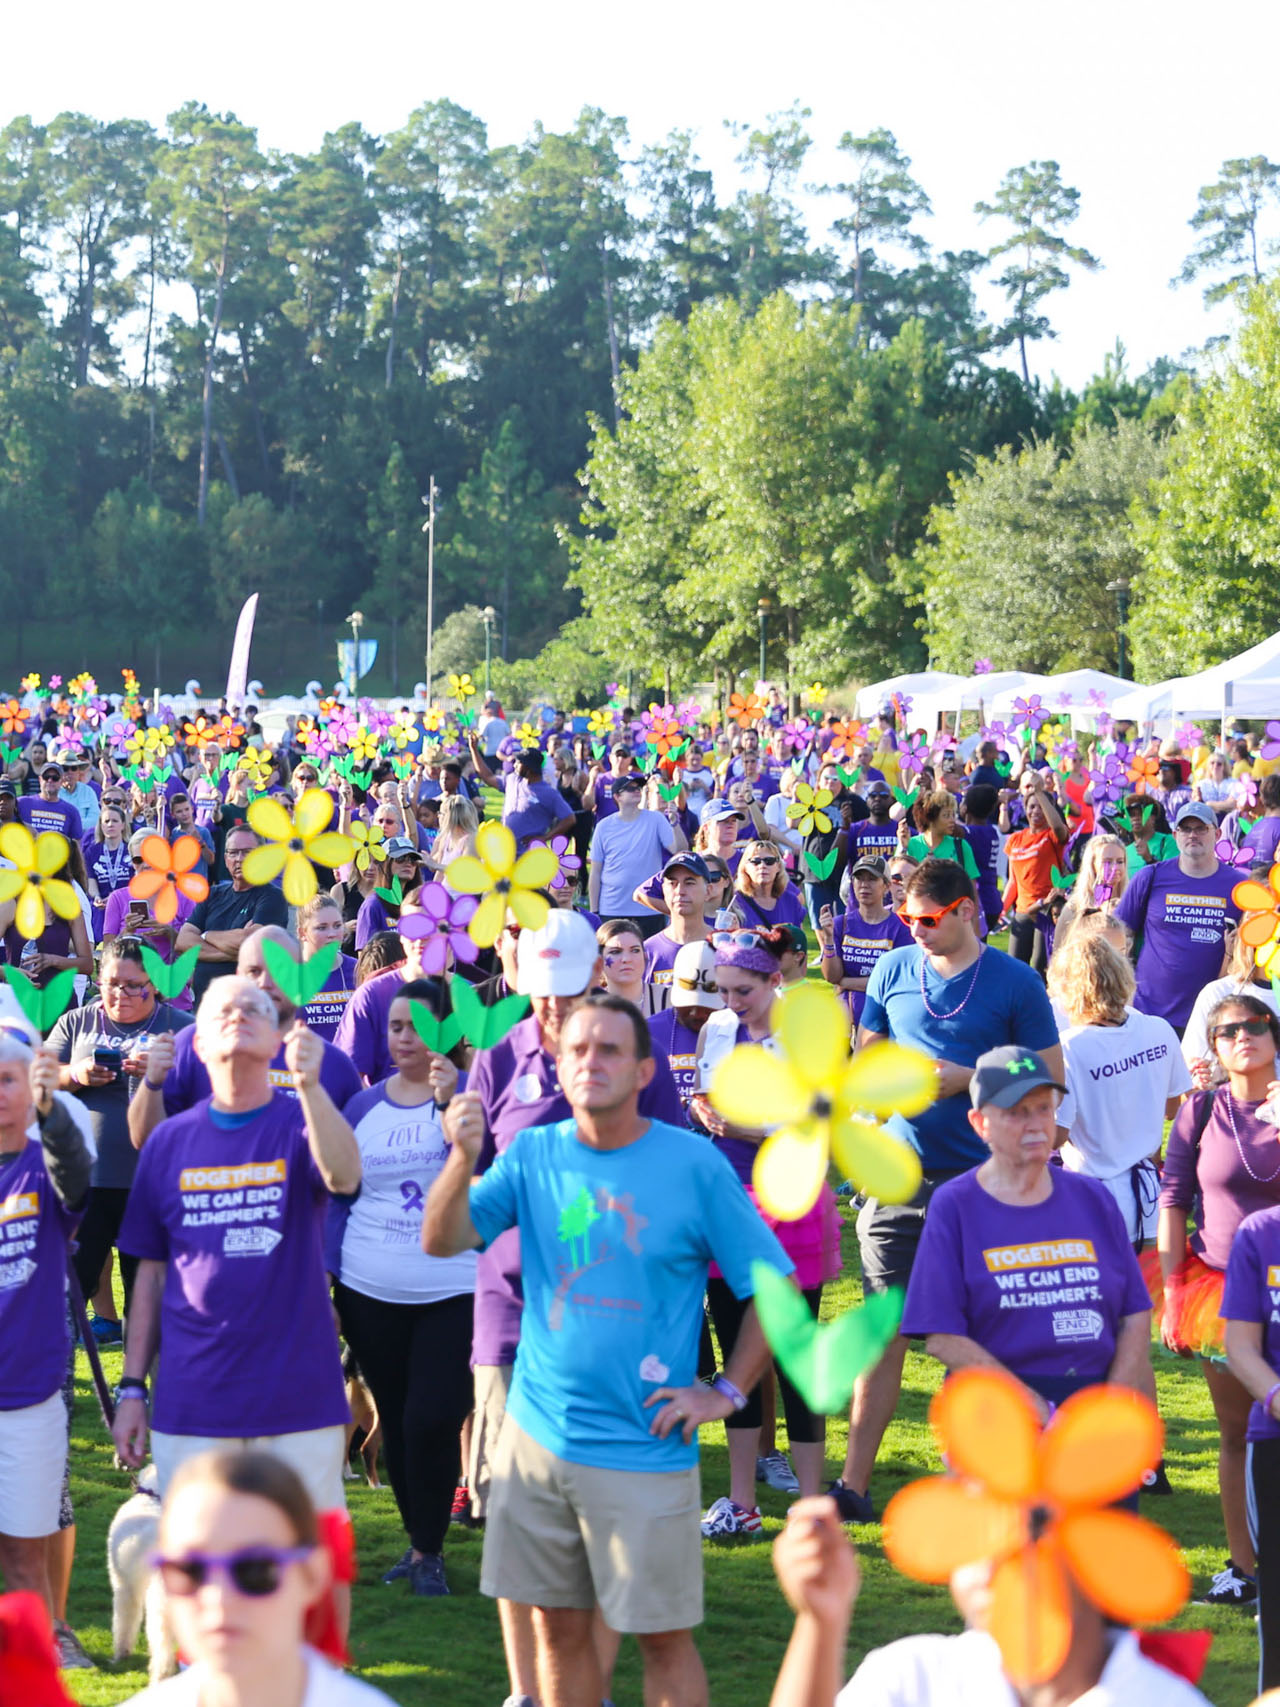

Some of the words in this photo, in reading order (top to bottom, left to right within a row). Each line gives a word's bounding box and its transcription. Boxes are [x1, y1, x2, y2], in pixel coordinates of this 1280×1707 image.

[1166, 906, 1182, 914] WE
[1183, 907, 1203, 915] CAN
[1205, 908, 1225, 917] END
[305, 1005, 323, 1014] WE
[324, 1004, 344, 1013] CAN
[1089, 1044, 1168, 1081] VOLUNTEER
[182, 1193, 210, 1209] WE
[212, 1190, 244, 1208] CAN
[247, 1186, 282, 1204] END
[994, 1273, 1027, 1289] WE
[1028, 1270, 1062, 1287] CAN
[1062, 1266, 1100, 1283] END
[999, 1286, 1104, 1308] ALZHEIMER'S.
[1055, 1320, 1090, 1331] END
